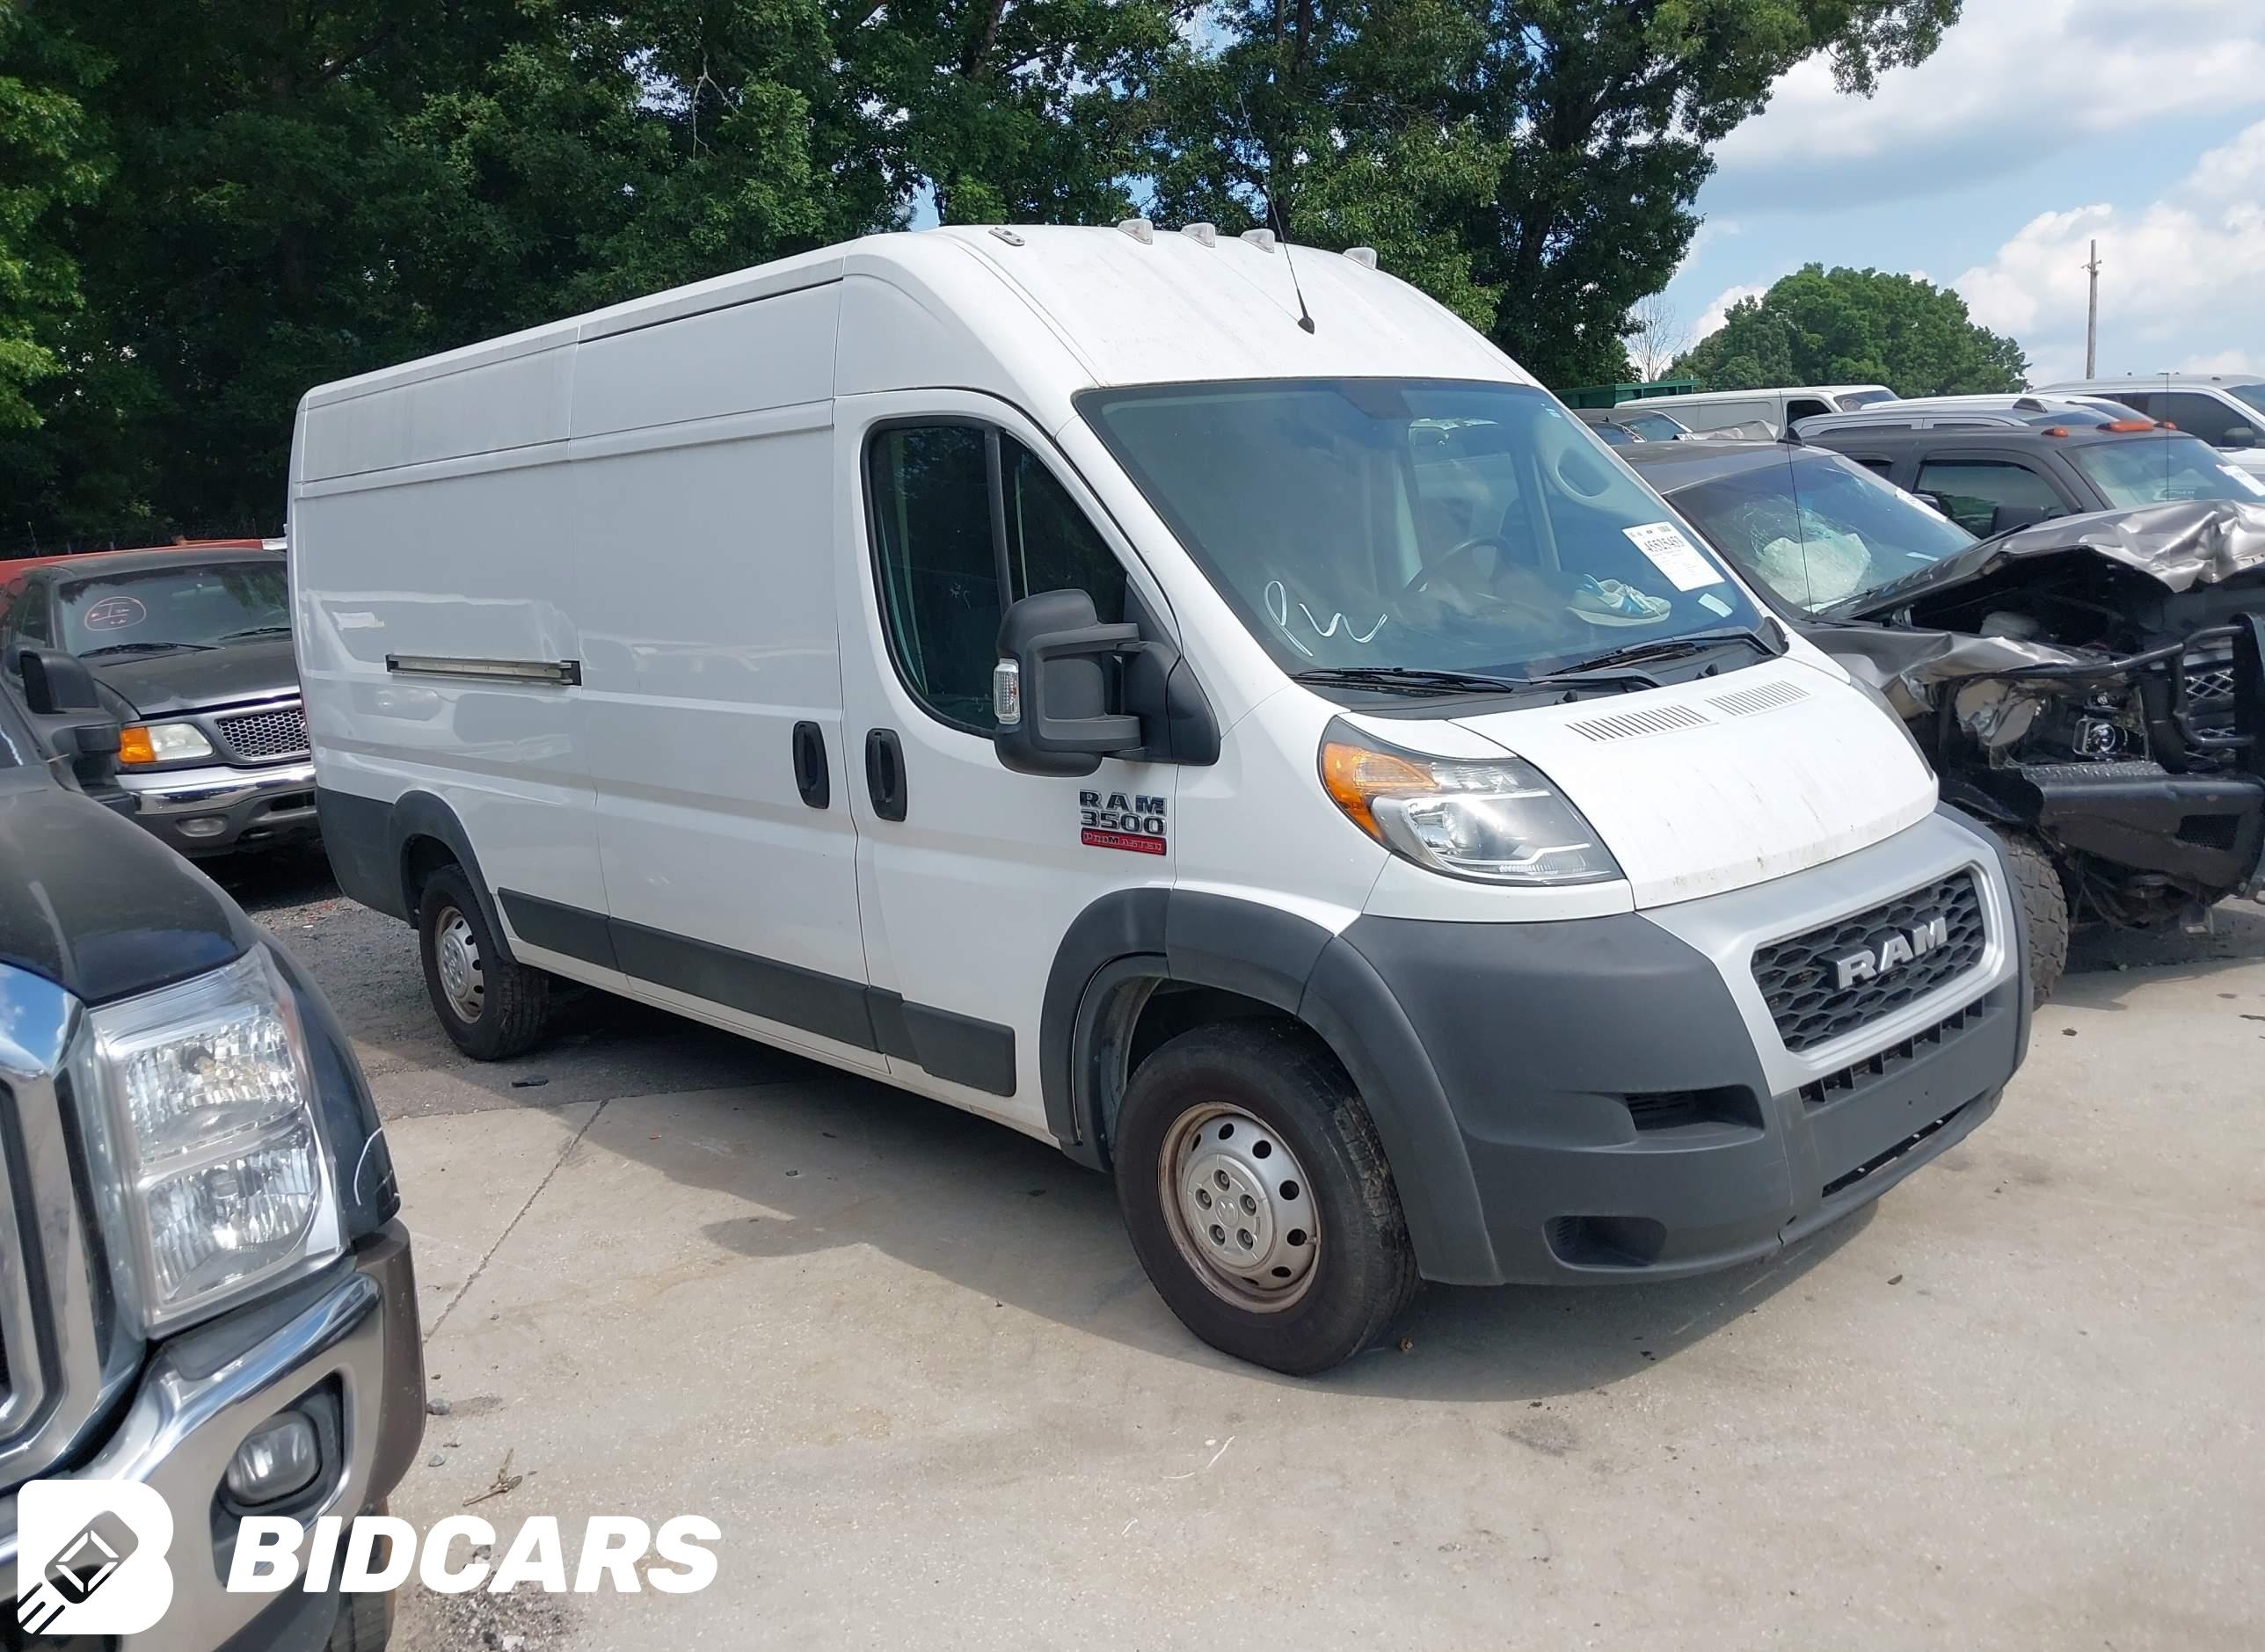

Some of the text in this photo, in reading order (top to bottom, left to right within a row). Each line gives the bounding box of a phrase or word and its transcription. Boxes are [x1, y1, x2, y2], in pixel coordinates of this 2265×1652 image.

[1079, 790, 1168, 817] RAM
[1081, 809, 1168, 836] 3500
[1835, 915, 1948, 990] RAM
